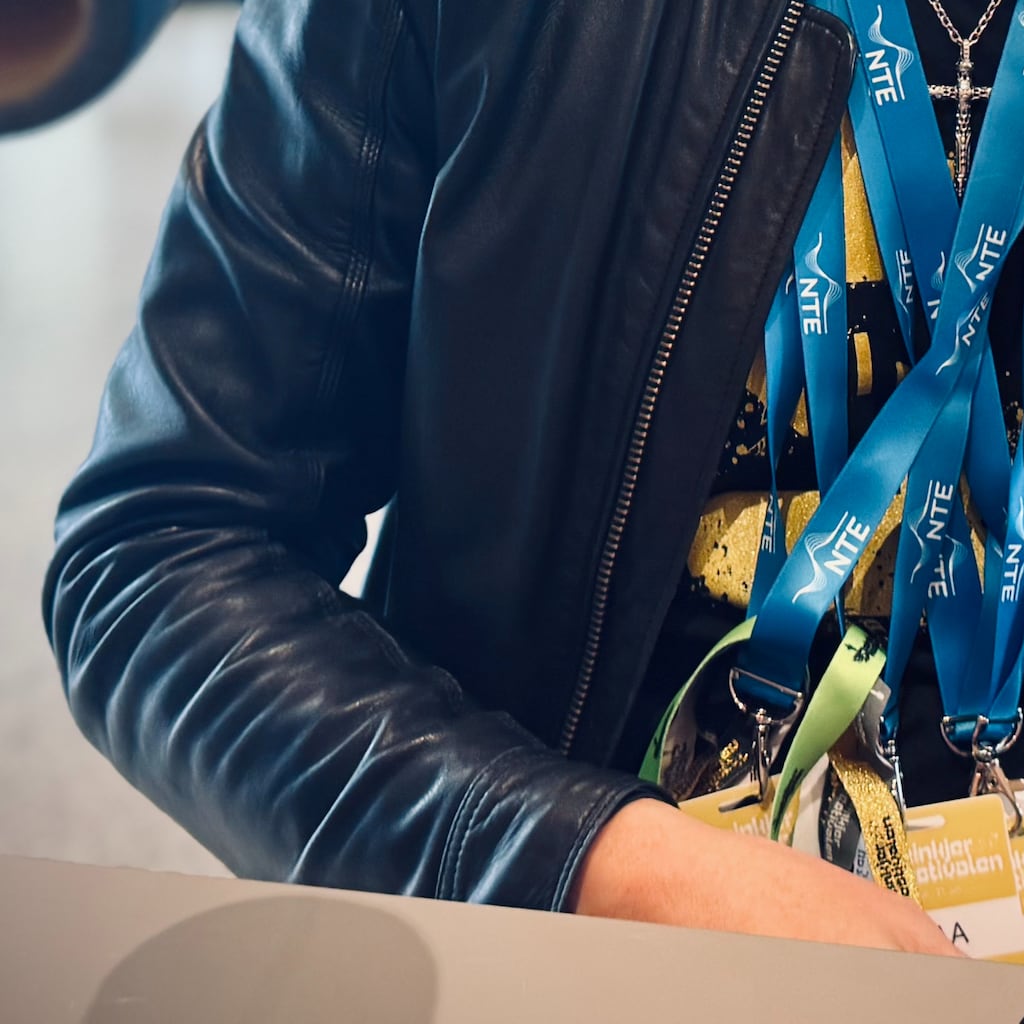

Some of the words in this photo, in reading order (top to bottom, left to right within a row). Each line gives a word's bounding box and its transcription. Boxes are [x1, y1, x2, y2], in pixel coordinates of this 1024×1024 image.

[865, 49, 898, 106] NTE
[899, 249, 913, 304] NTE
[975, 225, 1007, 281] NTE
[799, 278, 822, 335] NTE
[962, 295, 990, 347] NTE
[926, 481, 954, 541] NTE
[824, 516, 871, 576] NTE
[1001, 544, 1022, 603] NTE
[927, 554, 949, 599] TE
